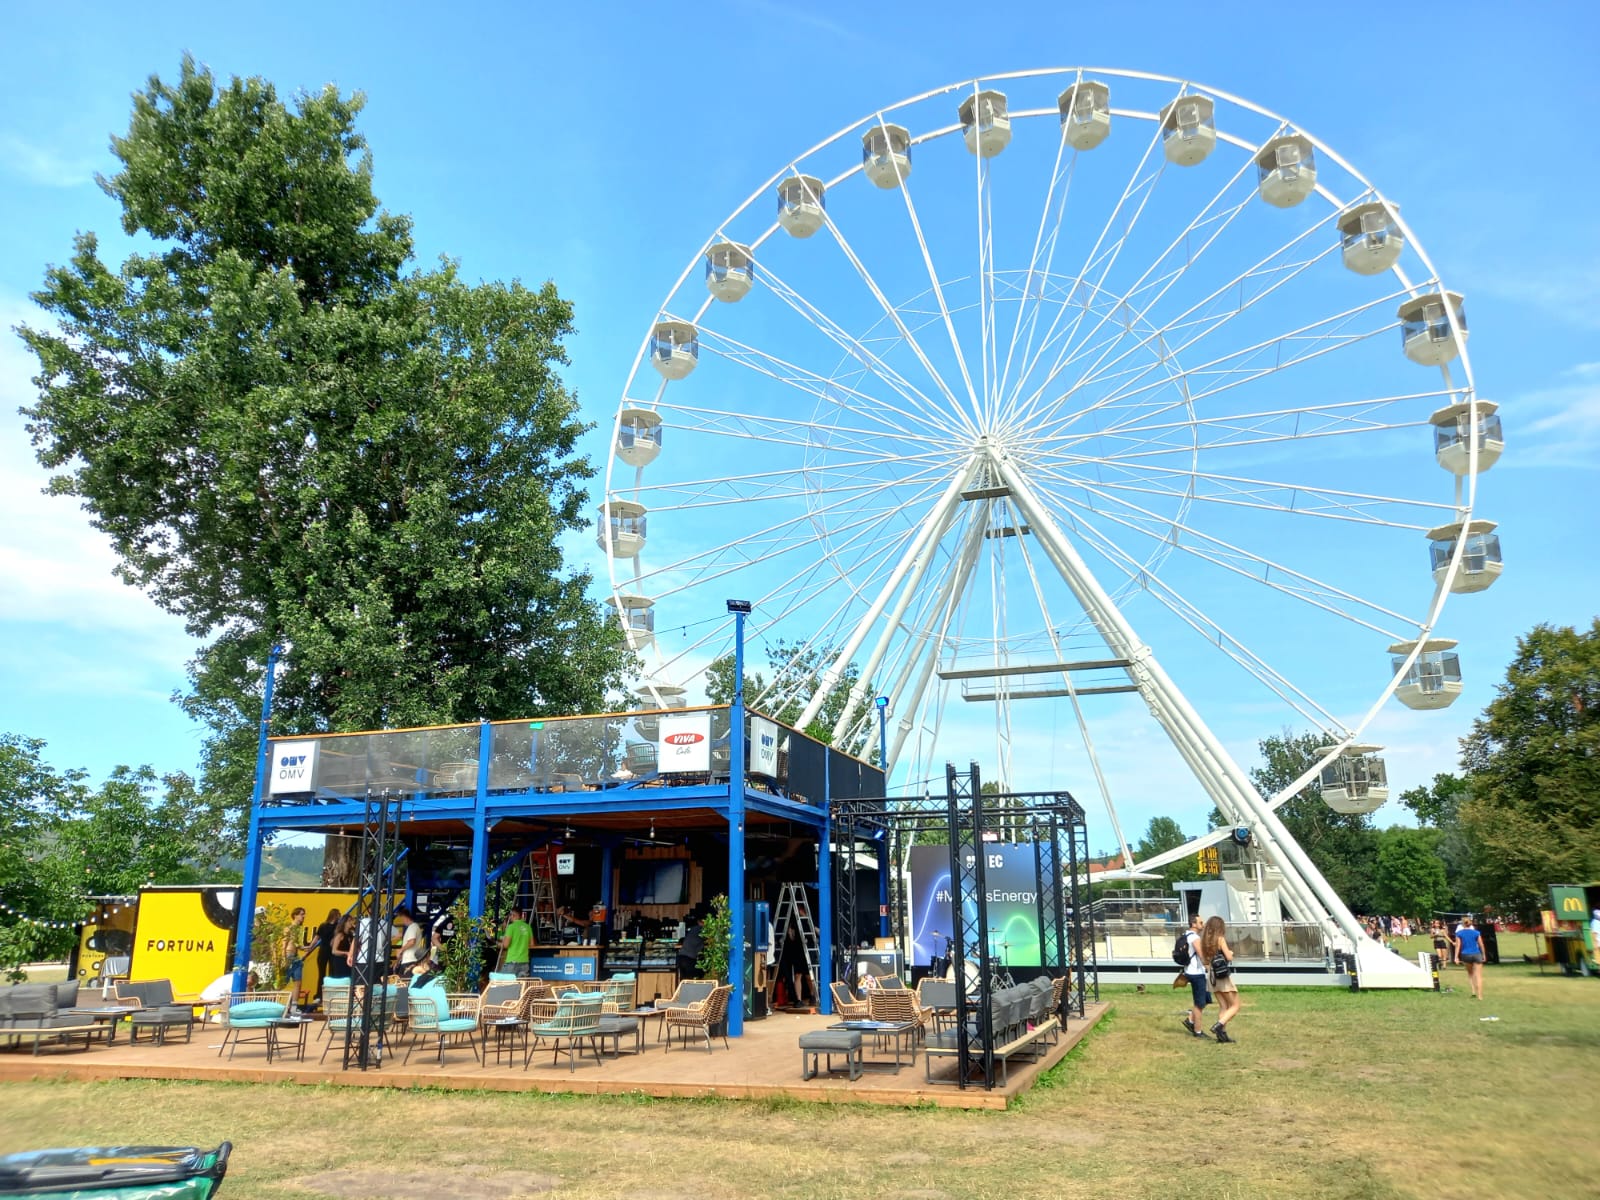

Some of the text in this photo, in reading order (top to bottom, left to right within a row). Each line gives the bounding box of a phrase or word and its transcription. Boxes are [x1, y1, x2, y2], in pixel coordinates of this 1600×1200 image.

[674, 735, 695, 743] VIVA
[280, 769, 304, 779] OMV
[989, 855, 1003, 868] EC
[147, 940, 214, 952] FORTUNA
